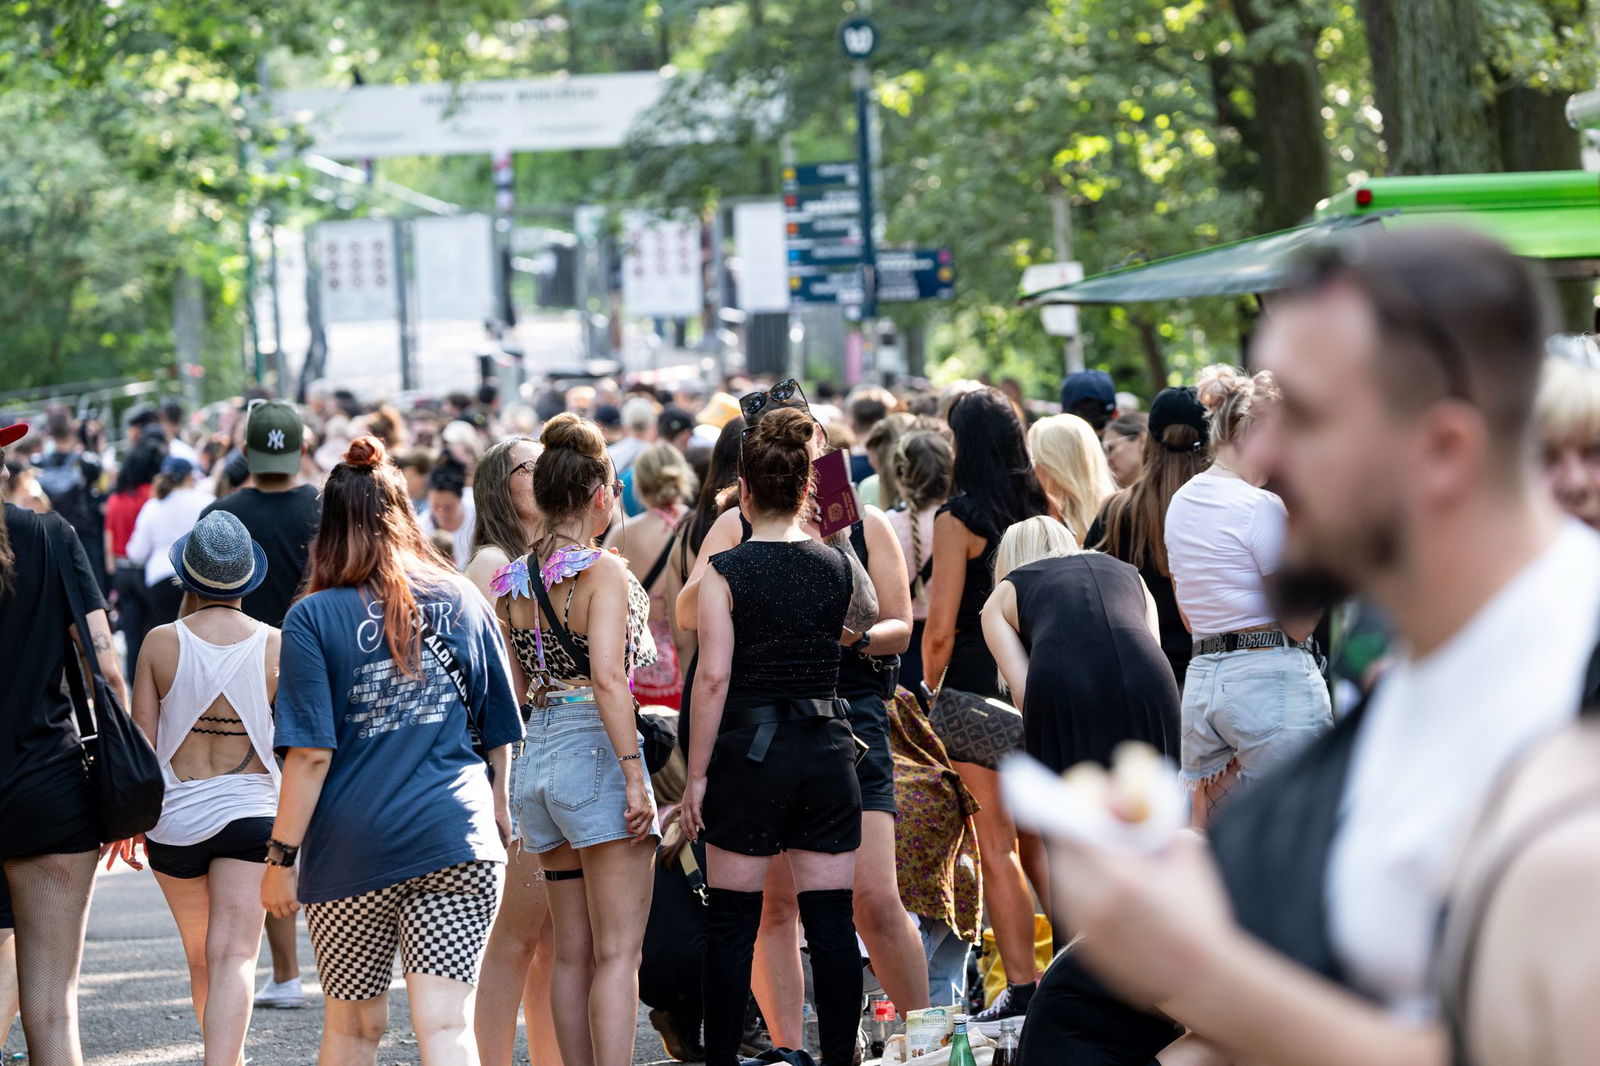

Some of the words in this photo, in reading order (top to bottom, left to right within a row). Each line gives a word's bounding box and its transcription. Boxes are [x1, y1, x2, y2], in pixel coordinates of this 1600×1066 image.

[267, 429, 285, 450] NY
[1236, 631, 1283, 649] BEYOND
[424, 635, 454, 667] ALDI
